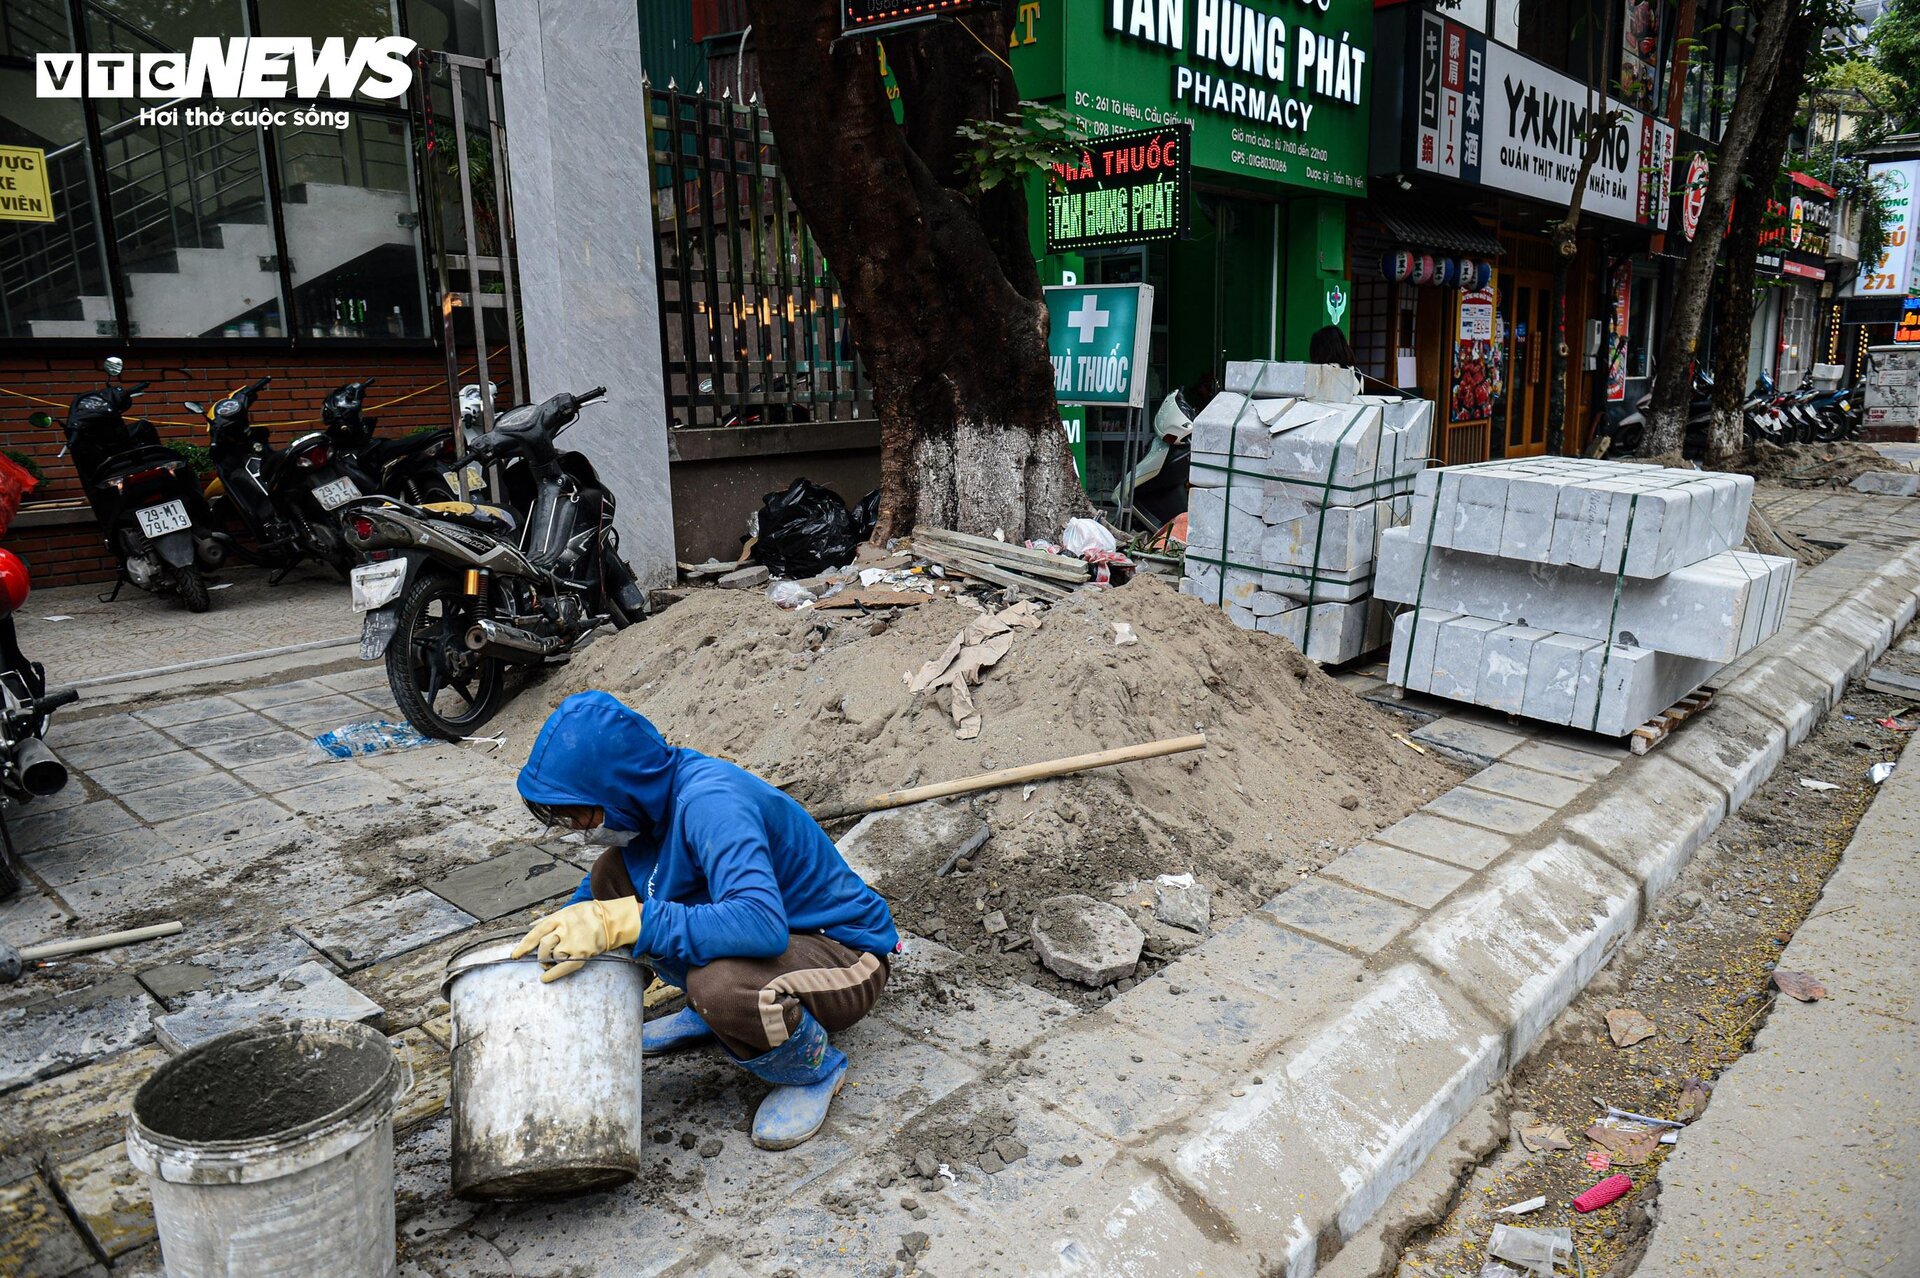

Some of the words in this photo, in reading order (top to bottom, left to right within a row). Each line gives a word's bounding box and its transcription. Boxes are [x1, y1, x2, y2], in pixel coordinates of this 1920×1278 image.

[1009, 2, 1040, 48] T
[1297, 30, 1366, 105] PHÁT
[1074, 90, 1090, 107] ĐC
[1095, 96, 1109, 112] 261
[1144, 105, 1161, 123] Cầu
[1176, 65, 1314, 132] PHARMACY
[1463, 48, 1482, 167] 日本酒
[0, 155, 34, 172] ỰC
[1103, 135, 1175, 175] THUỐC
[1231, 150, 1245, 165] GPS
[1500, 146, 1529, 170] QUÁN
[1532, 156, 1554, 183] THỊT
[1555, 164, 1587, 188] NƯỚ
[1589, 172, 1610, 199] NHẬT
[1, 195, 43, 213] VIÊN
[1132, 172, 1175, 232] PHÁT
[1863, 273, 1896, 290] 271
[1077, 342, 1129, 394] THUỐC
[144, 503, 178, 523] 29-M1
[146, 514, 188, 537] 794.19
